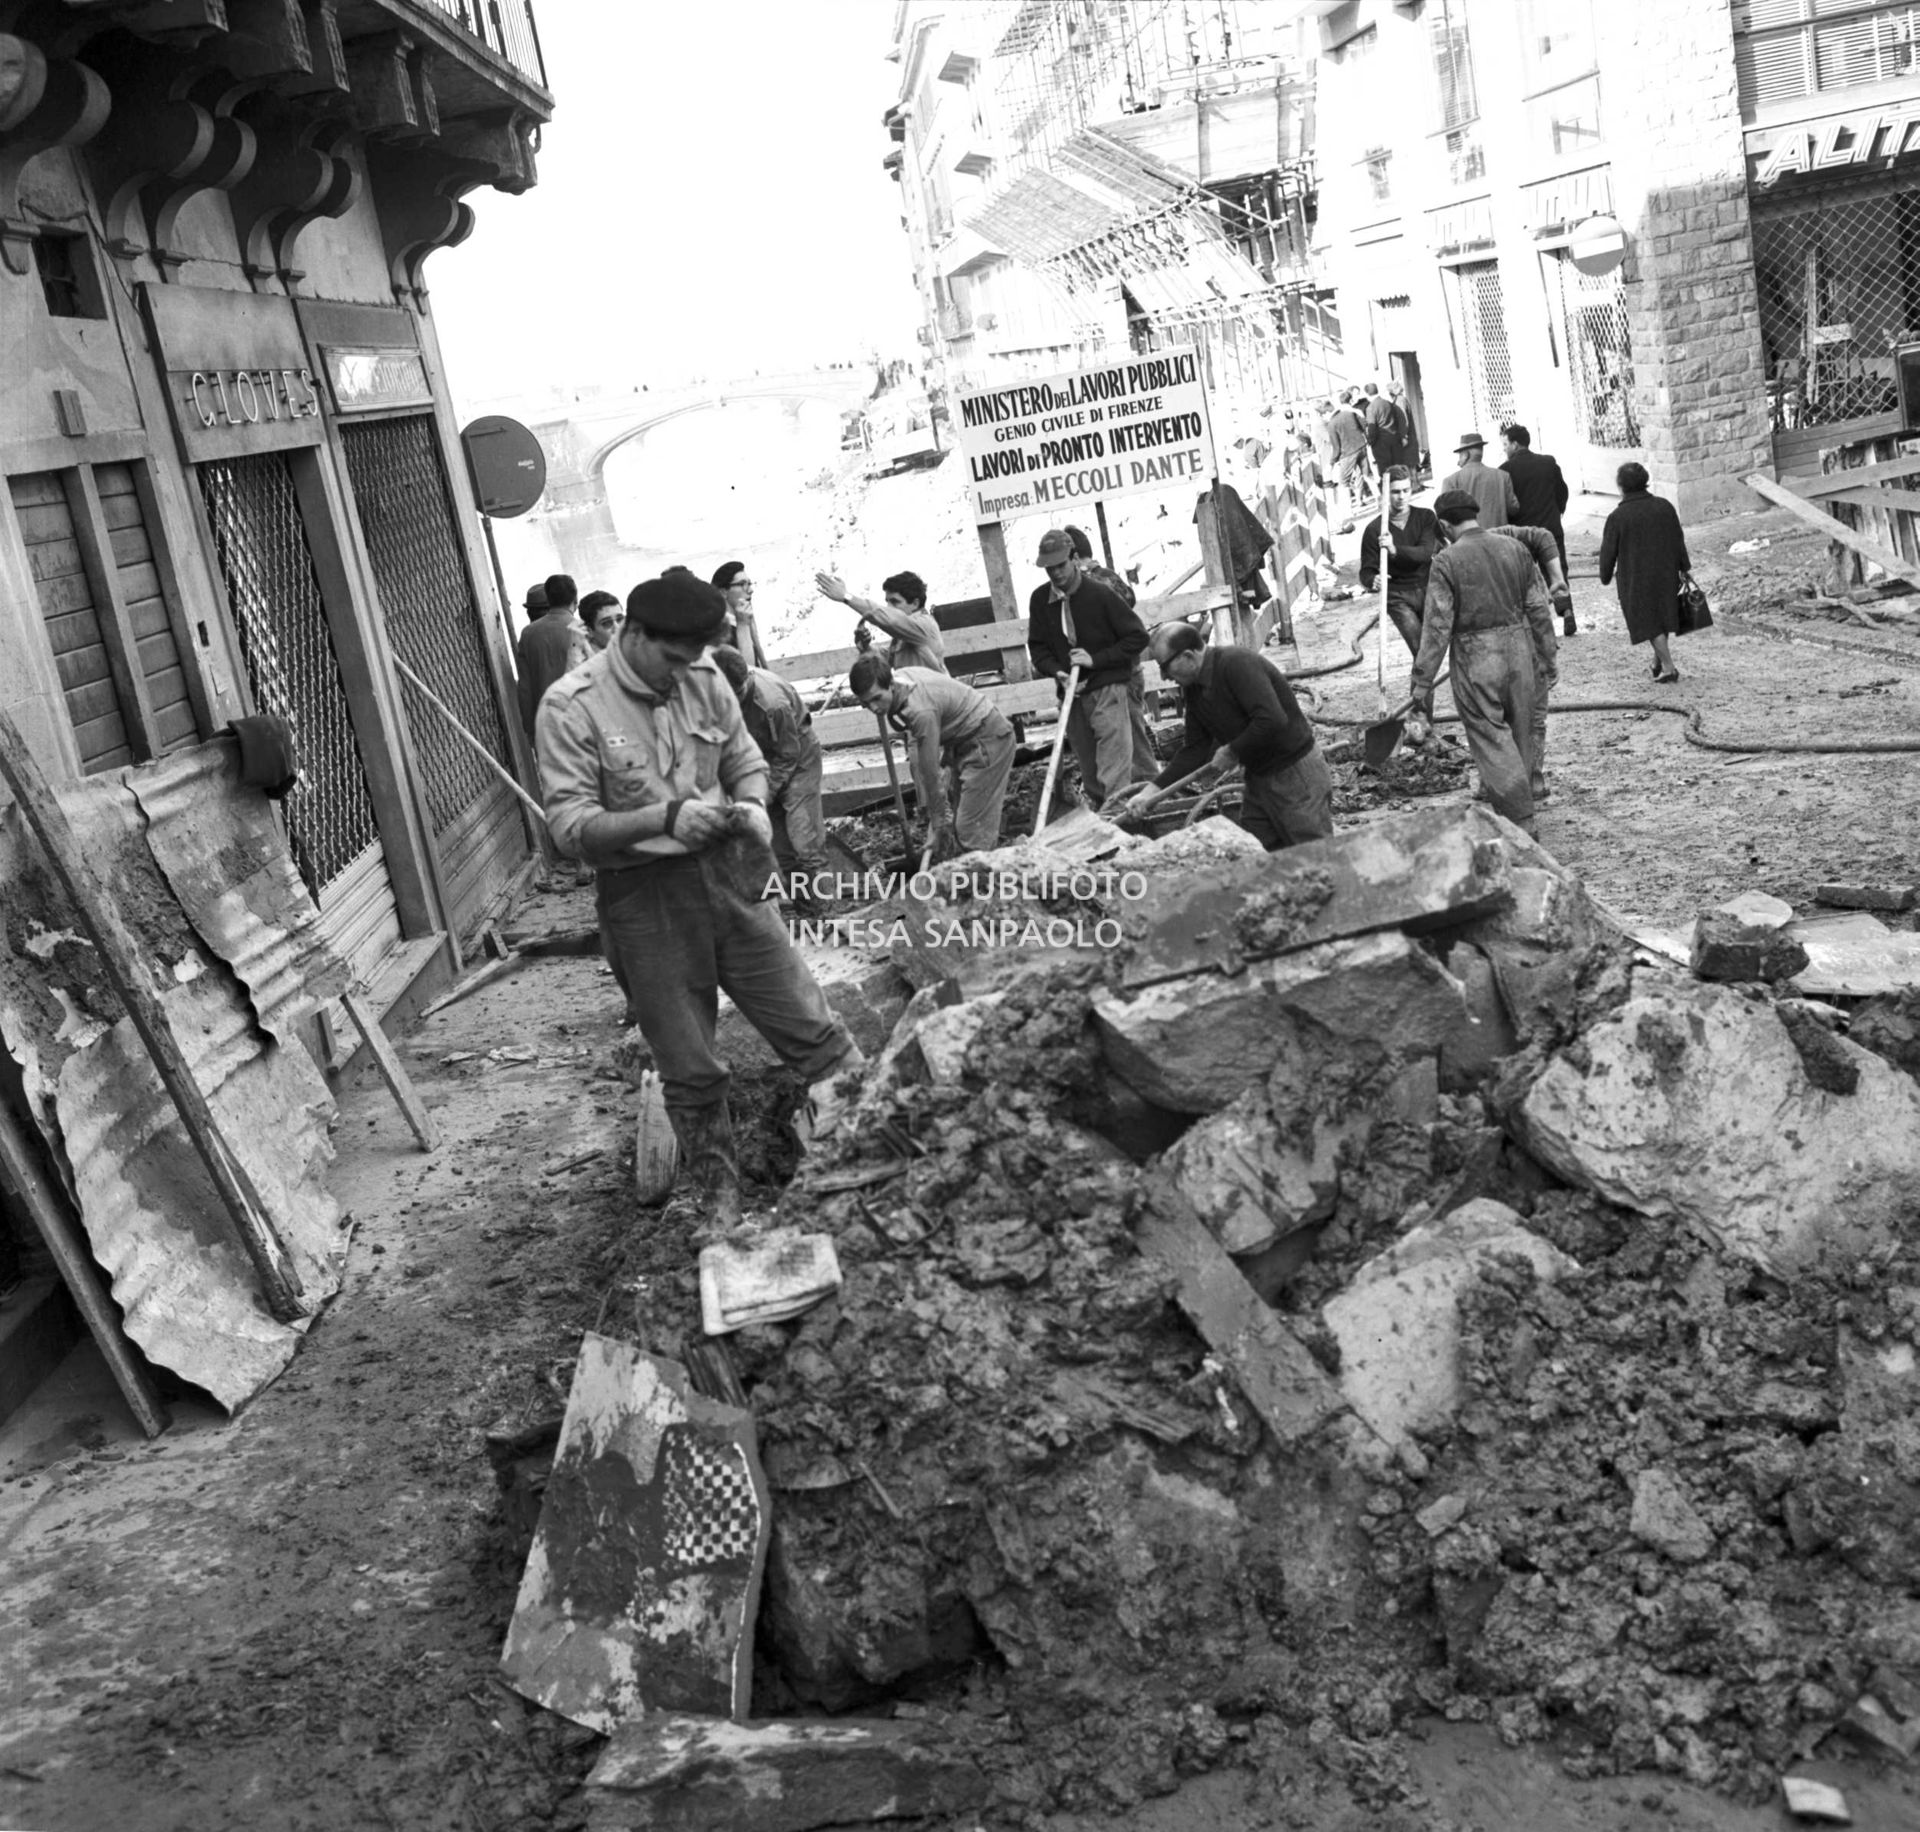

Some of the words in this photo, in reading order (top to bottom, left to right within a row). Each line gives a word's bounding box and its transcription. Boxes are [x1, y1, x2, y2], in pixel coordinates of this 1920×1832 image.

[1755, 107, 1920, 184] ALIT
[960, 383, 1054, 428] MINISTERO
[1053, 391, 1071, 410] DEI
[1068, 367, 1127, 407] LAVORI
[1126, 353, 1197, 394] PUBBLICI
[994, 421, 1037, 443] GENIO
[1041, 411, 1086, 433] CIVILE
[1089, 407, 1104, 423] DI
[1107, 396, 1163, 419] FIRENZE
[970, 447, 1026, 482] LAVORI
[1040, 431, 1104, 469] PRONTO
[1108, 411, 1202, 454] INTERVENTO
[1033, 464, 1123, 504] MECCOLI
[1130, 448, 1204, 485] DANTE
